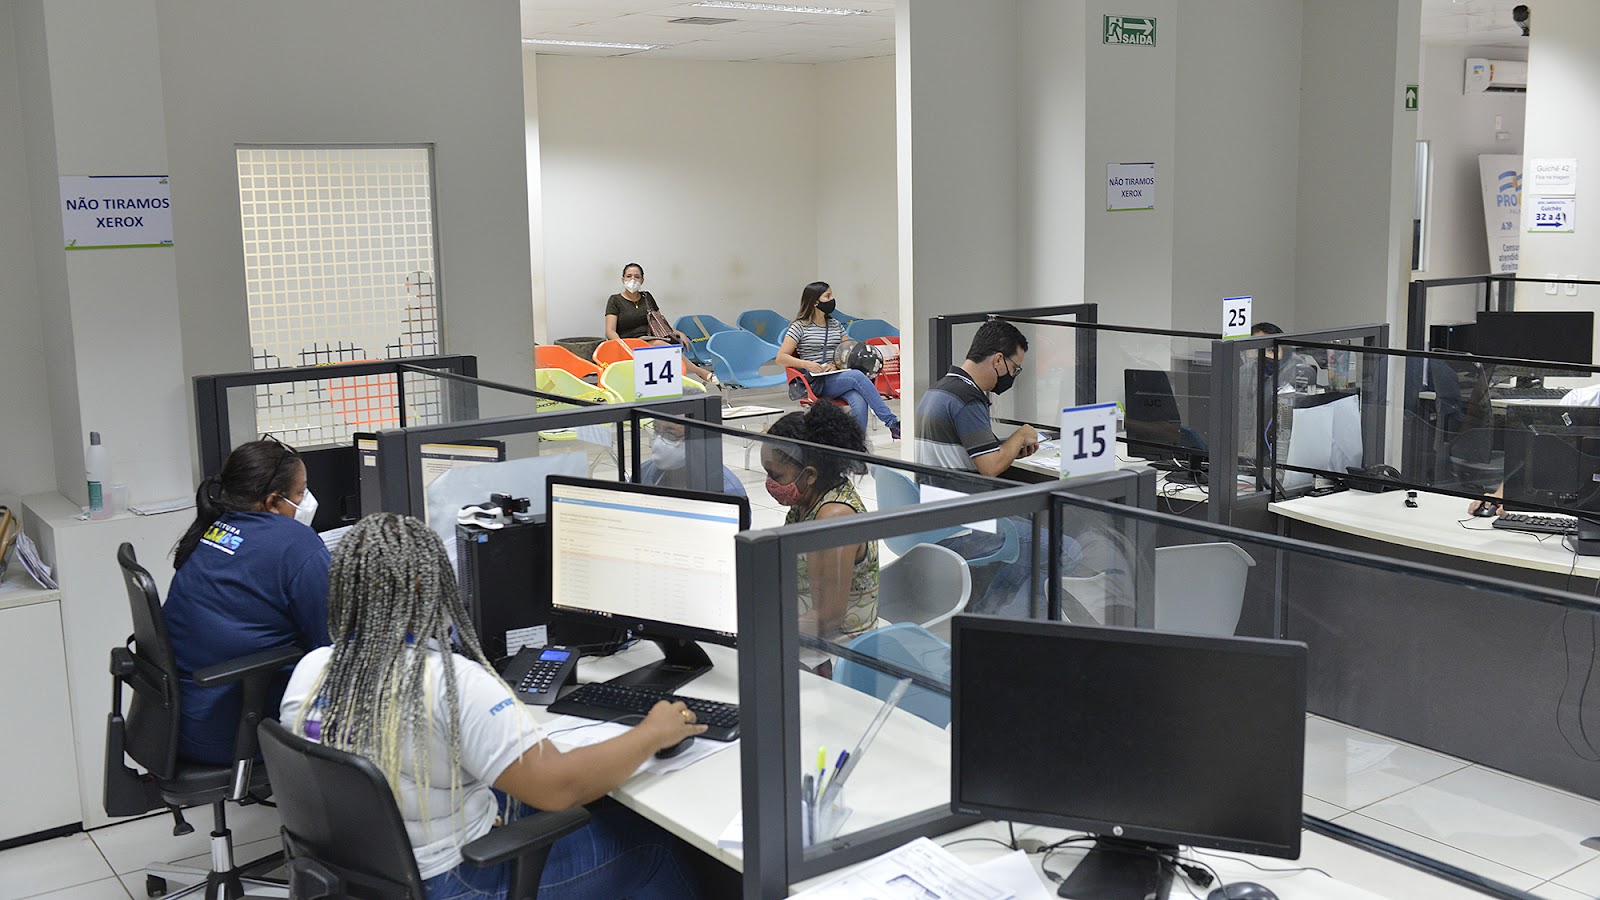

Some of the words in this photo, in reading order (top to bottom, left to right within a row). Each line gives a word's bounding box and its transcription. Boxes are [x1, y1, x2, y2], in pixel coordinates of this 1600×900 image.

[1122, 33, 1153, 45] SAÍDA
[1561, 164, 1570, 172] 42
[1109, 177, 1124, 186] NÃO
[1125, 177, 1154, 186] TIRAMOS
[66, 197, 99, 210] NÃO
[102, 198, 170, 210] TIRAMOS
[96, 216, 144, 228] XEROX
[1536, 213, 1547, 221] 32
[1228, 308, 1246, 327] 25
[643, 360, 674, 386] 14
[1073, 425, 1106, 460] 15
